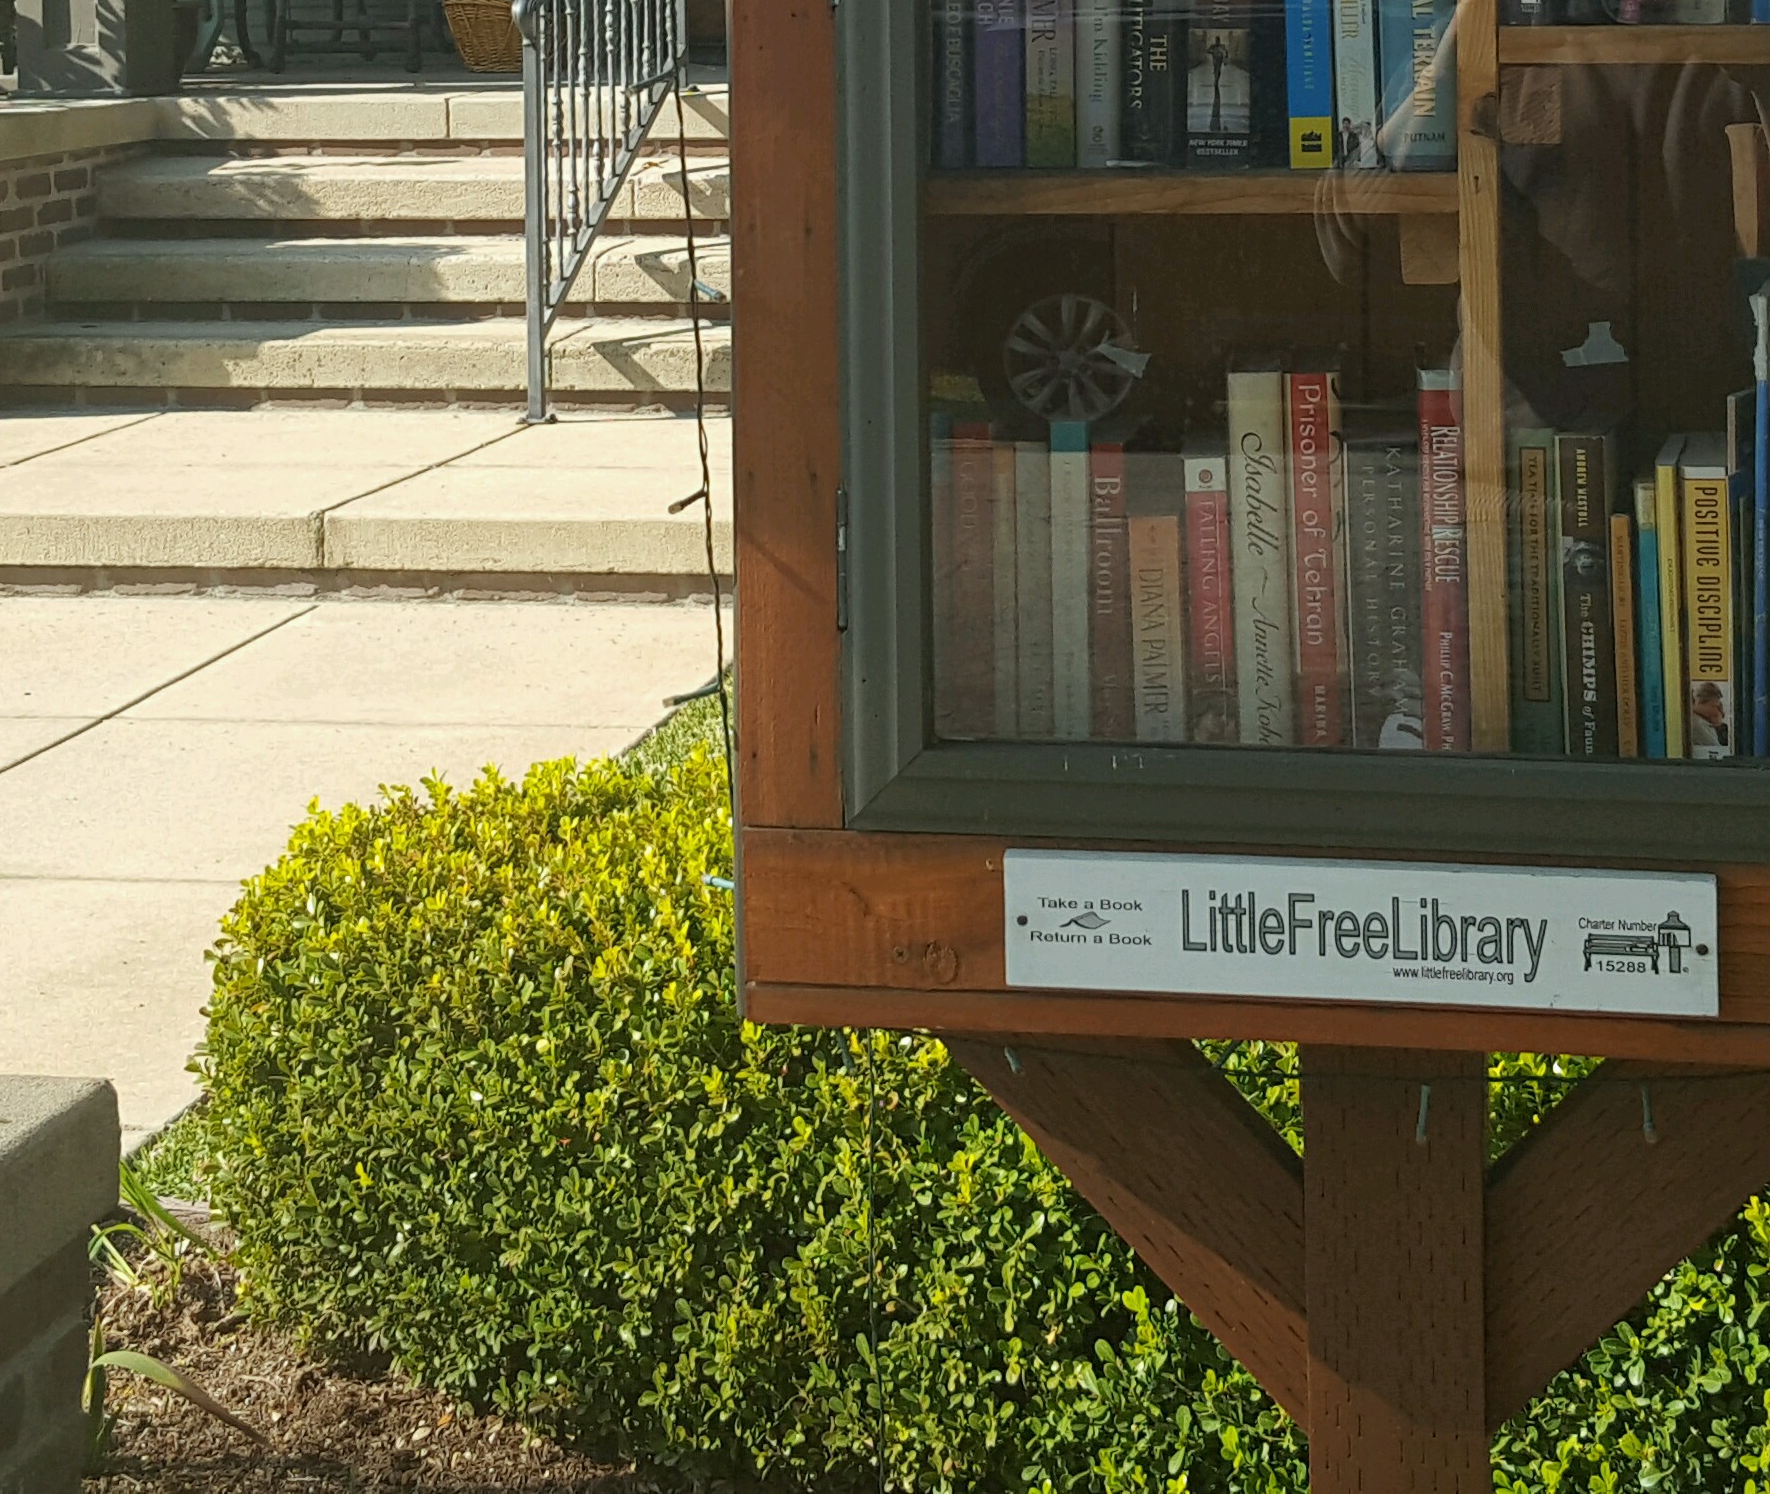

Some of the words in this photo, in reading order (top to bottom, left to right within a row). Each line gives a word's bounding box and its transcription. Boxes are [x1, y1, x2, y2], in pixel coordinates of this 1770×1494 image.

[945, 37, 963, 124] BUSCAGLIA
[1090, 37, 1109, 104] Kidding
[1149, 34, 1168, 72] THE
[1411, 27, 1437, 118] TERRAIN
[1404, 132, 1446, 143] PUTNAM
[1297, 383, 1325, 498] Prisoner
[1430, 425, 1461, 524] RELATIONSHIP
[1575, 449, 1587, 485] ANDREW
[1239, 431, 1280, 556] Isabelle
[1301, 509, 1326, 539] of
[1361, 465, 1377, 580] PERSONAL
[1385, 446, 1406, 591] KATHARINE
[1576, 487, 1588, 528] WESTOLL
[1694, 486, 1720, 567] POSITIVE
[1094, 475, 1122, 616] Ballroom
[1198, 500, 1218, 591] FALLING
[1432, 524, 1463, 584] RESCUE
[1138, 568, 1166, 632] DIANA
[1302, 548, 1328, 647] Tehran
[1580, 593, 1593, 618] The
[1696, 577, 1723, 674] DISCIPLINE
[1141, 639, 1169, 715] PALMER
[1202, 599, 1221, 683] ANGELS
[1251, 596, 1279, 687] Annette
[1364, 598, 1380, 697] HISTORY
[1388, 606, 1409, 714] GRAHAM
[1440, 631, 1453, 669] PHILLIP
[1580, 620, 1597, 702] CHIMPS
[1581, 705, 1594, 719] of
[1030, 931, 1087, 943] Return
[1093, 935, 1103, 944] a
[1109, 933, 1152, 946] Book
[1037, 897, 1078, 909] Take
[1084, 901, 1094, 909] a
[1100, 899, 1143, 911] Book
[1181, 889, 1548, 982] LittleFreeLibrary
[1578, 917, 1615, 930] Charter
[1618, 919, 1657, 932] Number
[1392, 966, 1514, 985] www.littlefreelibrary.org
[1596, 960, 1646, 973] 15288
